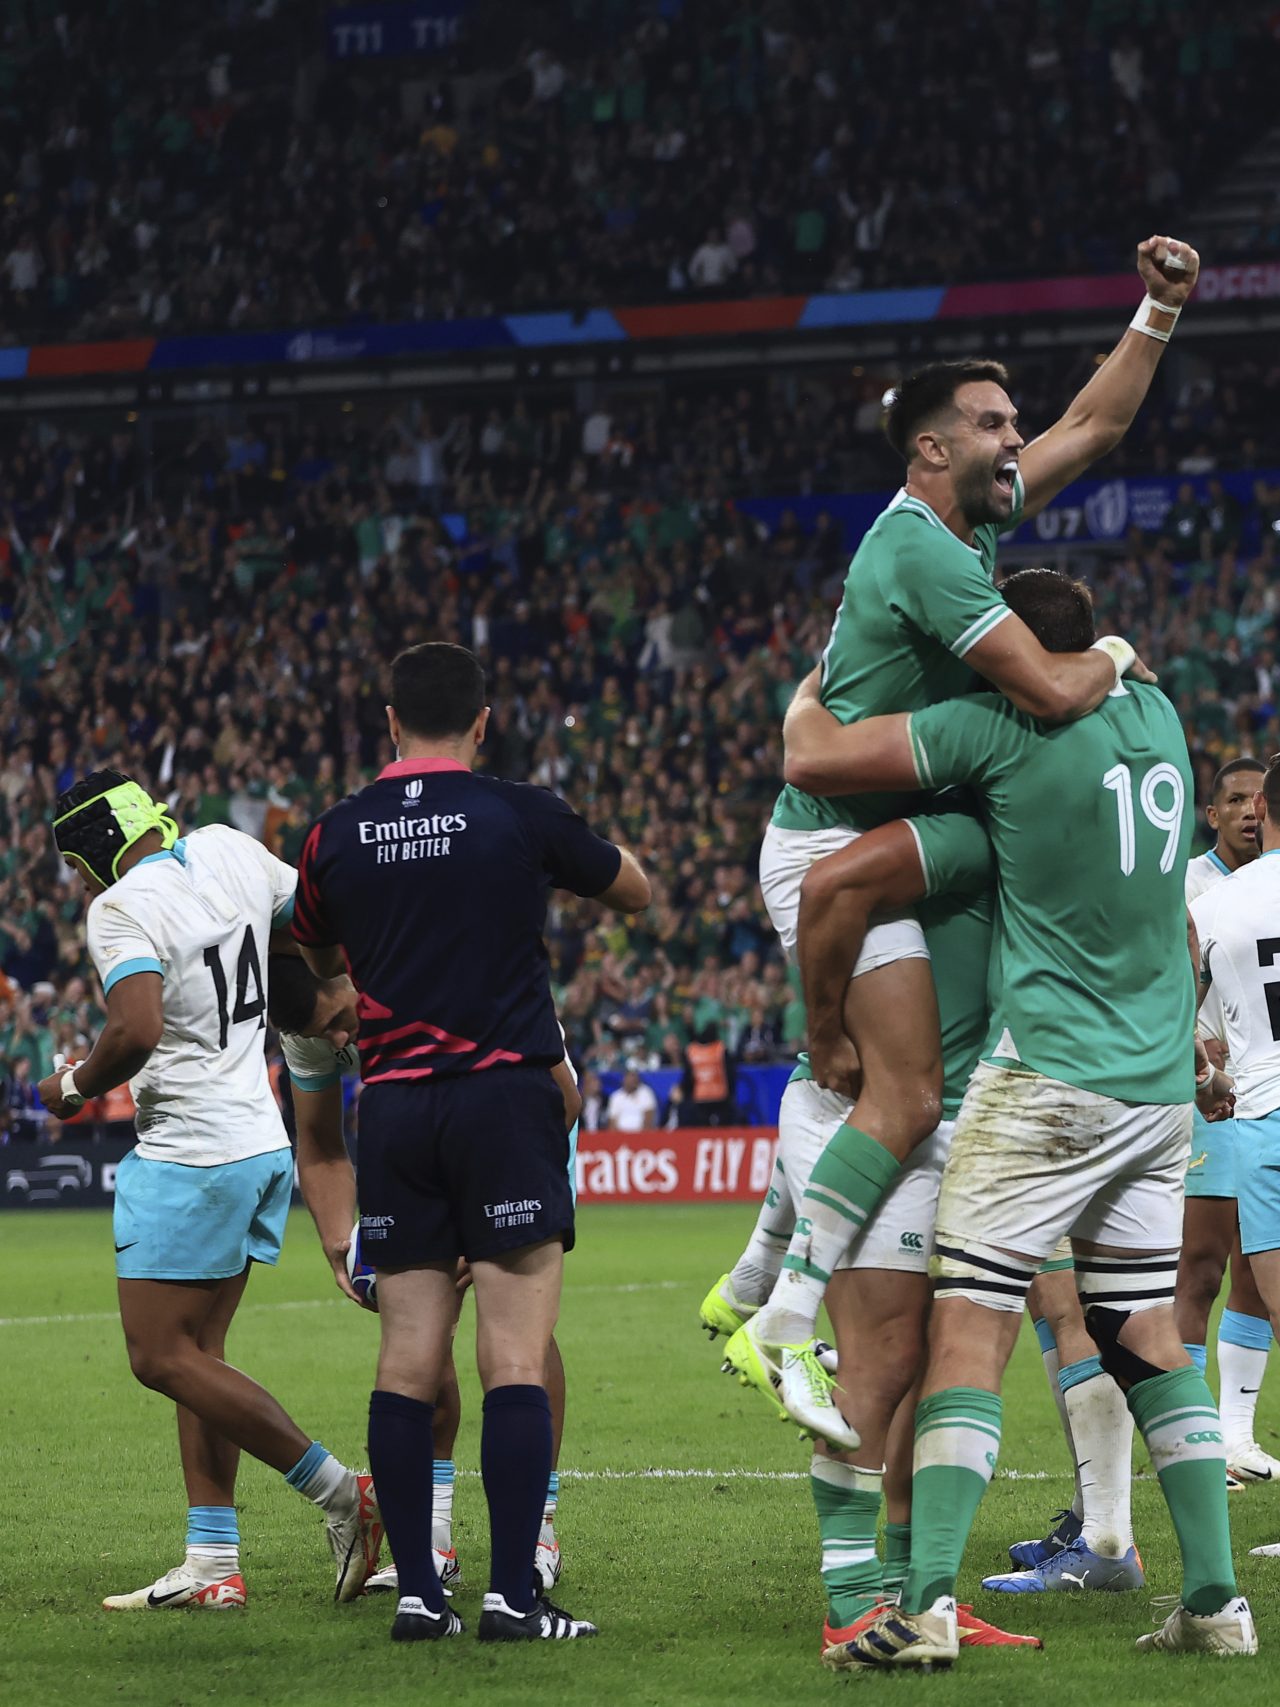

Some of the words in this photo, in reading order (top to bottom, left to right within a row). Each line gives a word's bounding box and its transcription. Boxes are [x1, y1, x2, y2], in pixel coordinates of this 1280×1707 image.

[1036, 508, 1082, 540] U7
[358, 813, 467, 844] Emirates
[1102, 762, 1185, 877] 19
[376, 843, 398, 864] FLY
[402, 837, 451, 860] BETTER
[204, 924, 266, 1050] 14
[575, 1144, 679, 1194] rates
[692, 1138, 747, 1193] FLY
[484, 1200, 542, 1218] Emirates
[507, 1213, 535, 1227] BETTER
